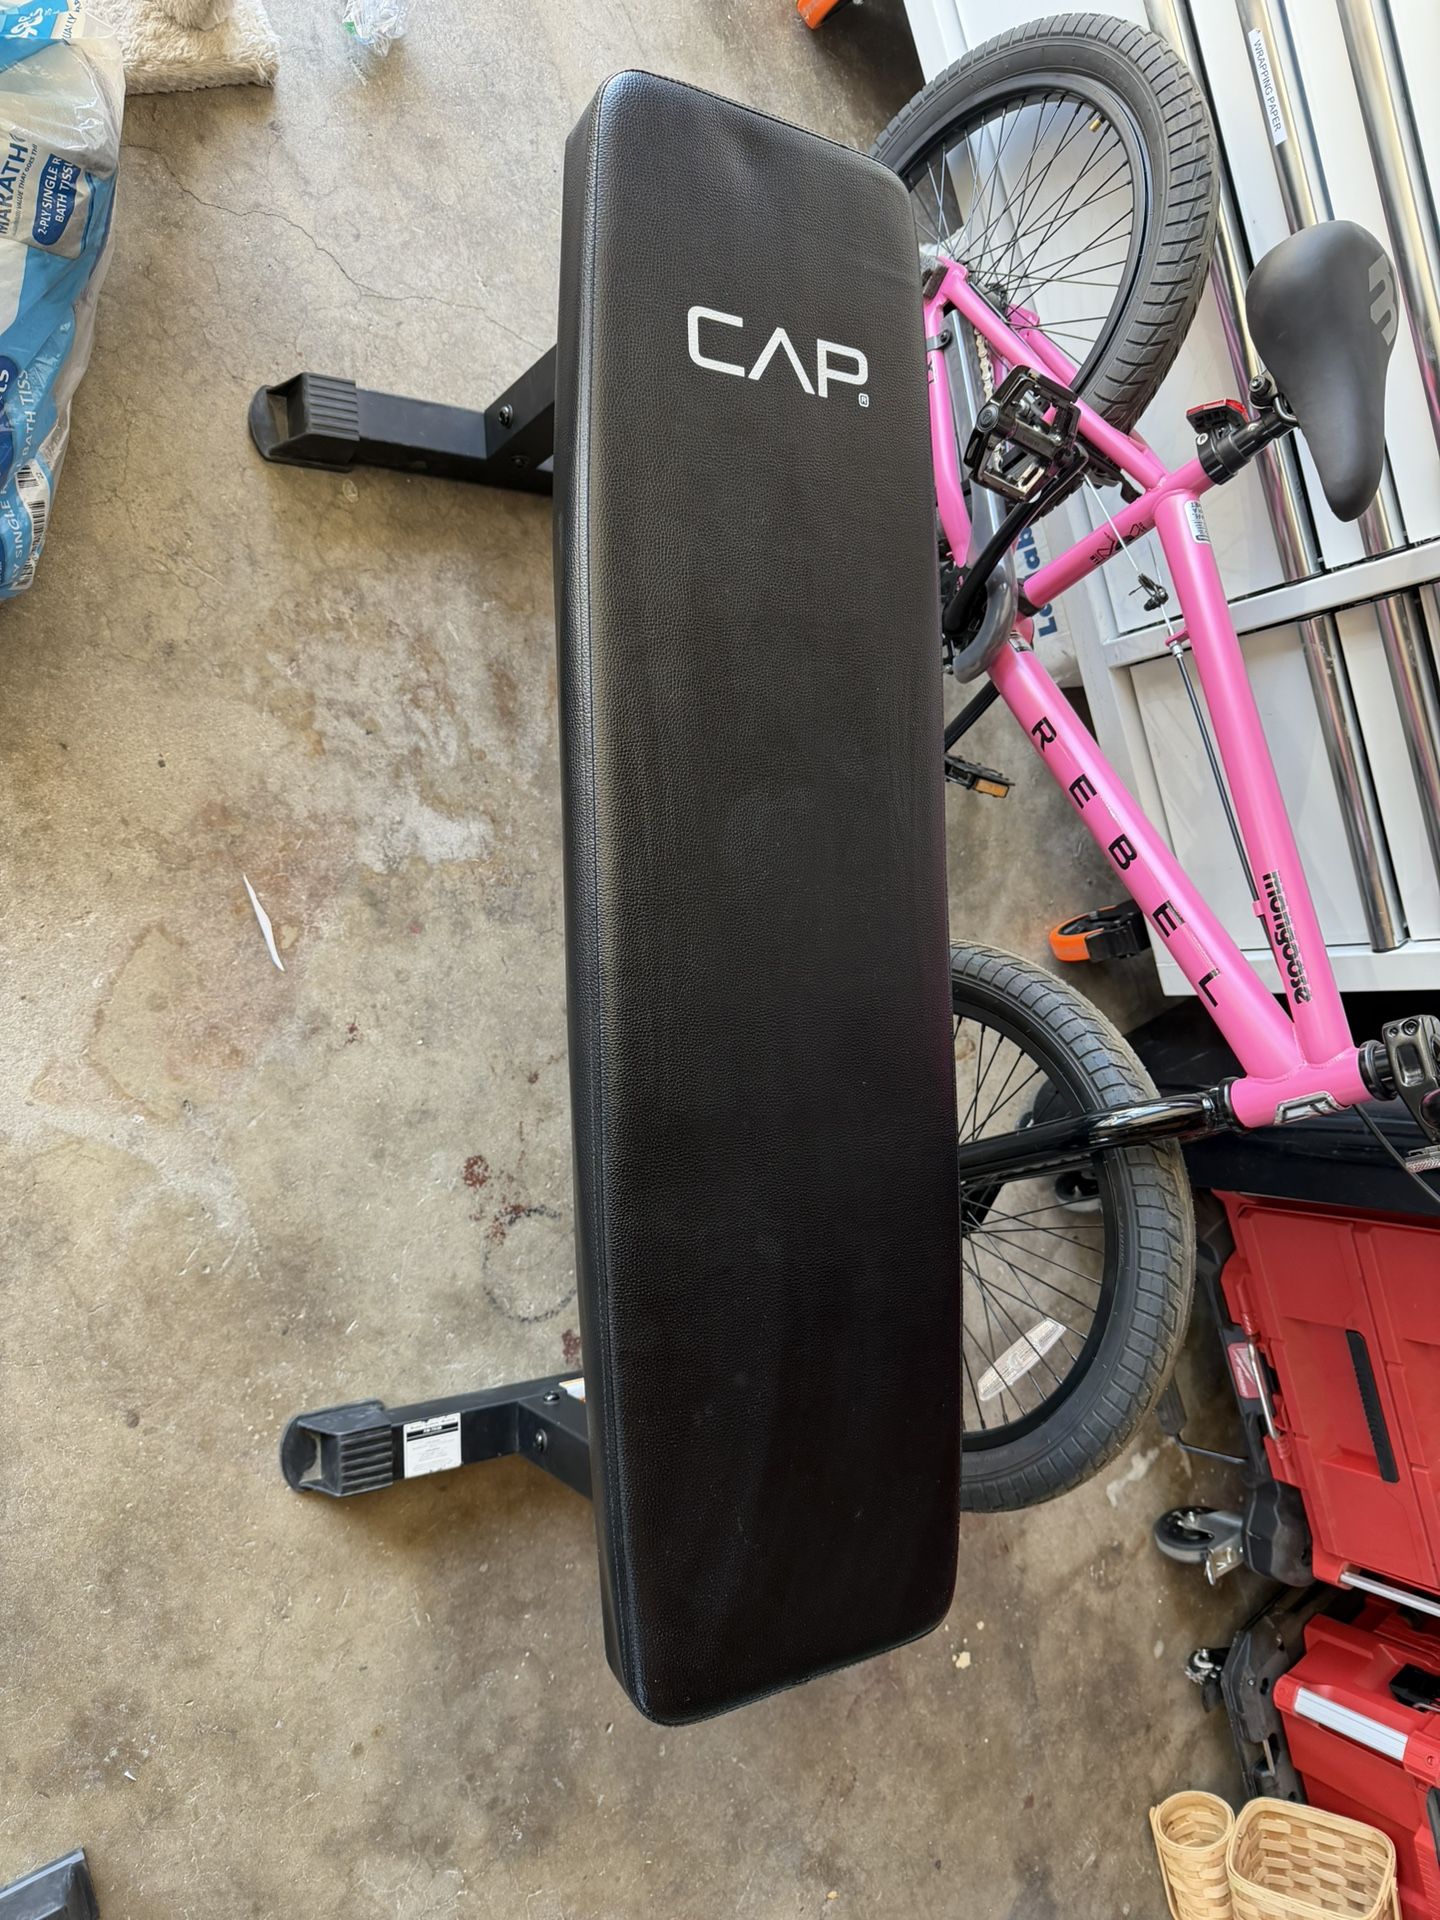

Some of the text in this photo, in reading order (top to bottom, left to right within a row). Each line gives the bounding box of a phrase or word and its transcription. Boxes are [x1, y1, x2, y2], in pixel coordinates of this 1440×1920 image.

[1253, 39, 1282, 132] WRAPPING PAPER
[0, 132, 28, 235] MARATH
[19, 173, 27, 191] THAT
[42, 166, 58, 209] SINGLE
[55, 193, 68, 223] BATH
[38, 208, 52, 236] 2-PLY
[687, 305, 869, 399] CAP
[0, 500, 24, 559] SINGLE
[1030, 715, 1222, 1009] REBEL
[1262, 869, 1312, 1005] mongoose
